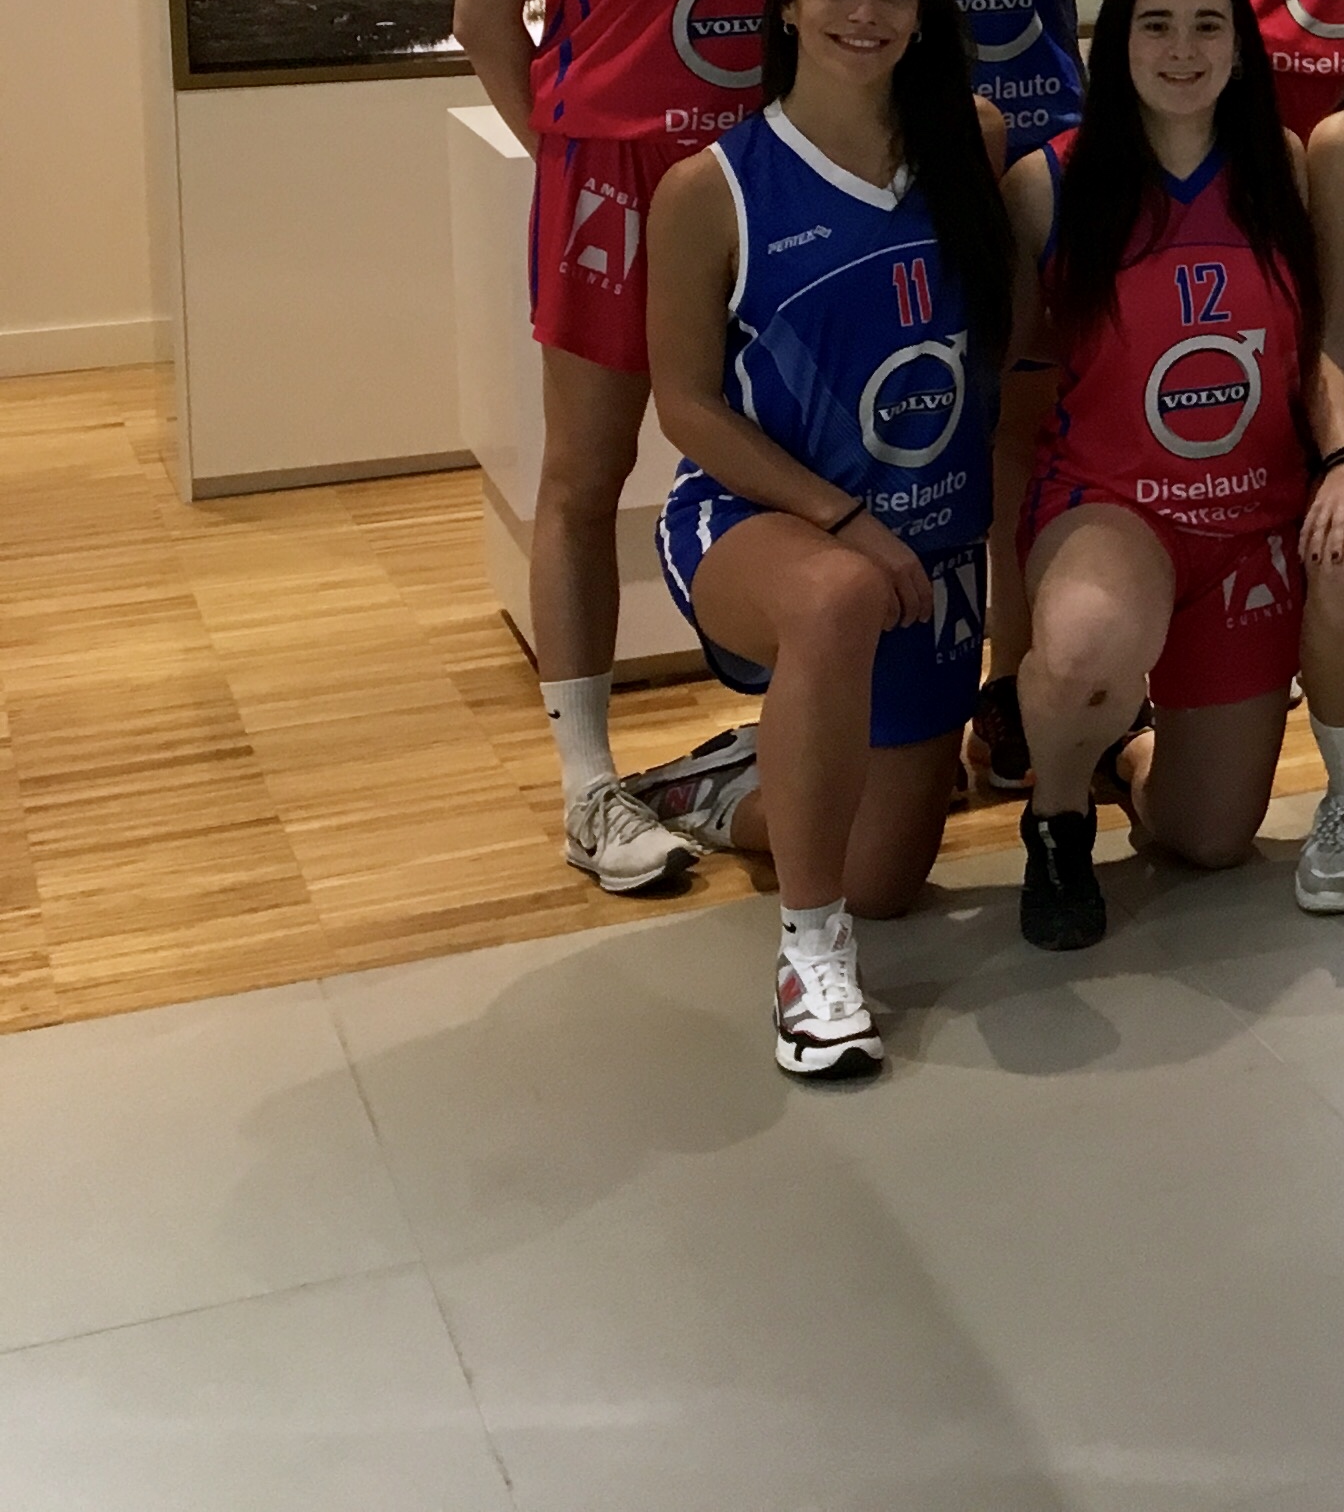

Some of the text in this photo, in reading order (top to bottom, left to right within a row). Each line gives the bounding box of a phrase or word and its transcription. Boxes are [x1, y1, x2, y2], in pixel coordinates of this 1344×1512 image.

[691, 19, 763, 35] VOLV
[976, 75, 1060, 100] elauto
[664, 105, 750, 134] Disel
[584, 177, 638, 208] AMBI
[892, 257, 932, 327] 11
[1175, 263, 1232, 326] 12
[878, 391, 954, 422] VOLVO
[1161, 385, 1245, 409] VOLVO
[855, 471, 967, 515] iselauto
[1137, 468, 1267, 503] Diselauto
